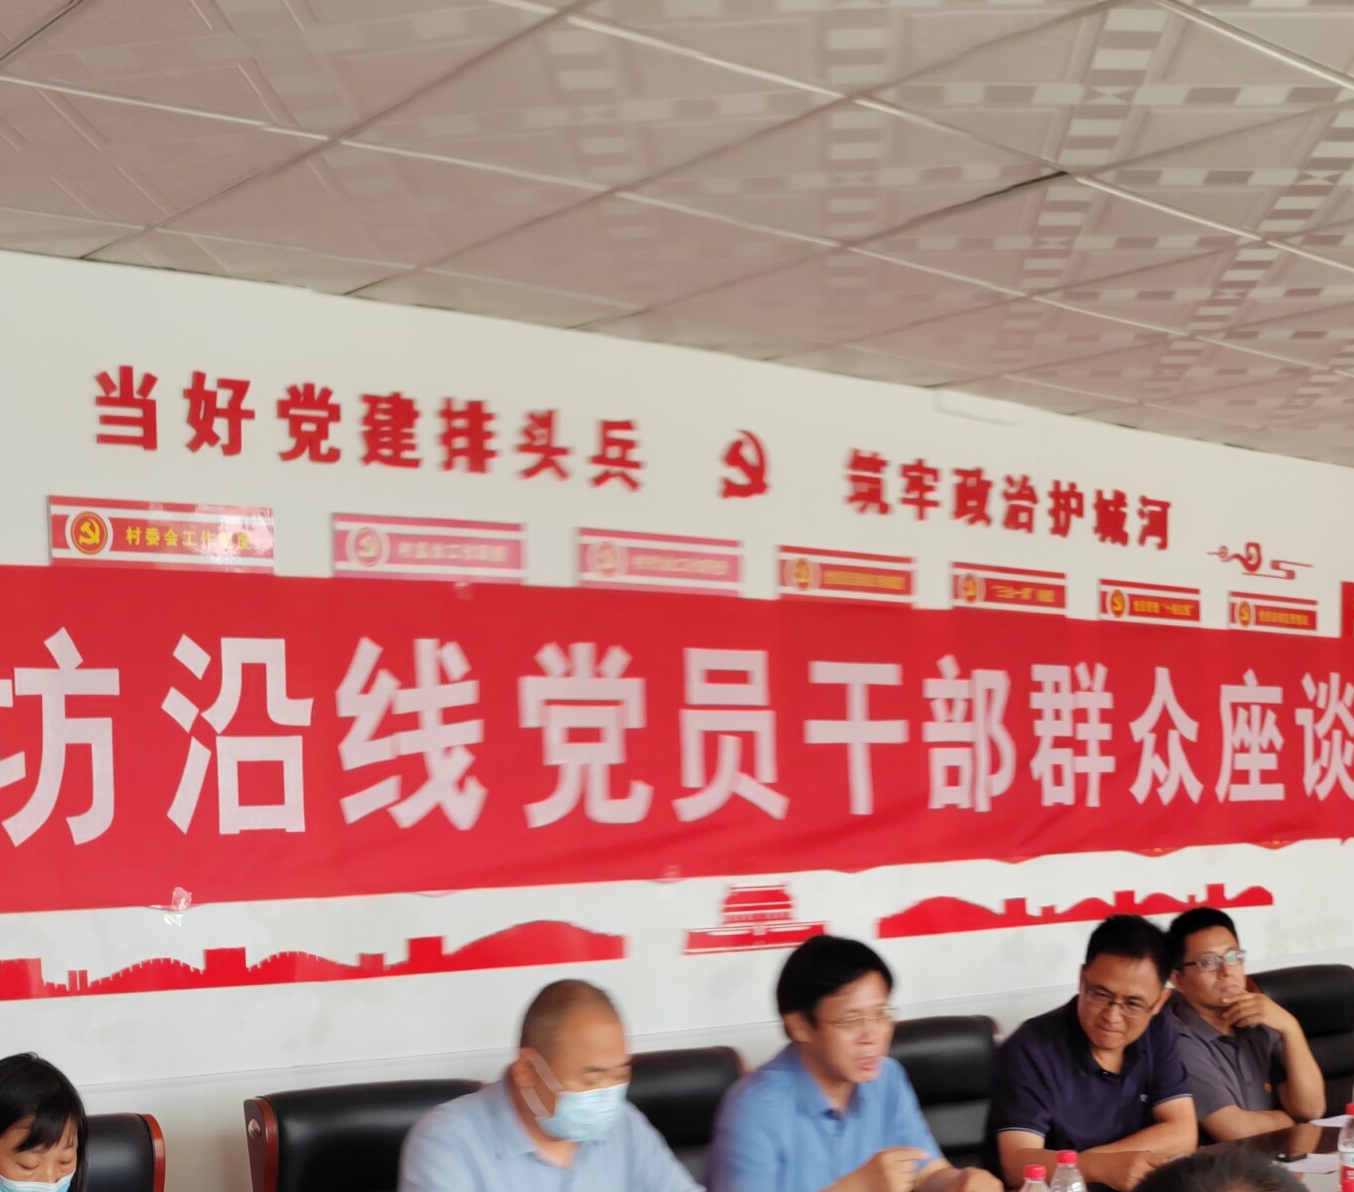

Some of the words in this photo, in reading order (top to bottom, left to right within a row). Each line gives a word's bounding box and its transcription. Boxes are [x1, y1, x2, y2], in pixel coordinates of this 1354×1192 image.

[95, 365, 645, 492] 当好党建排头兵
[845, 449, 1170, 550] 筑牢政治护城河
